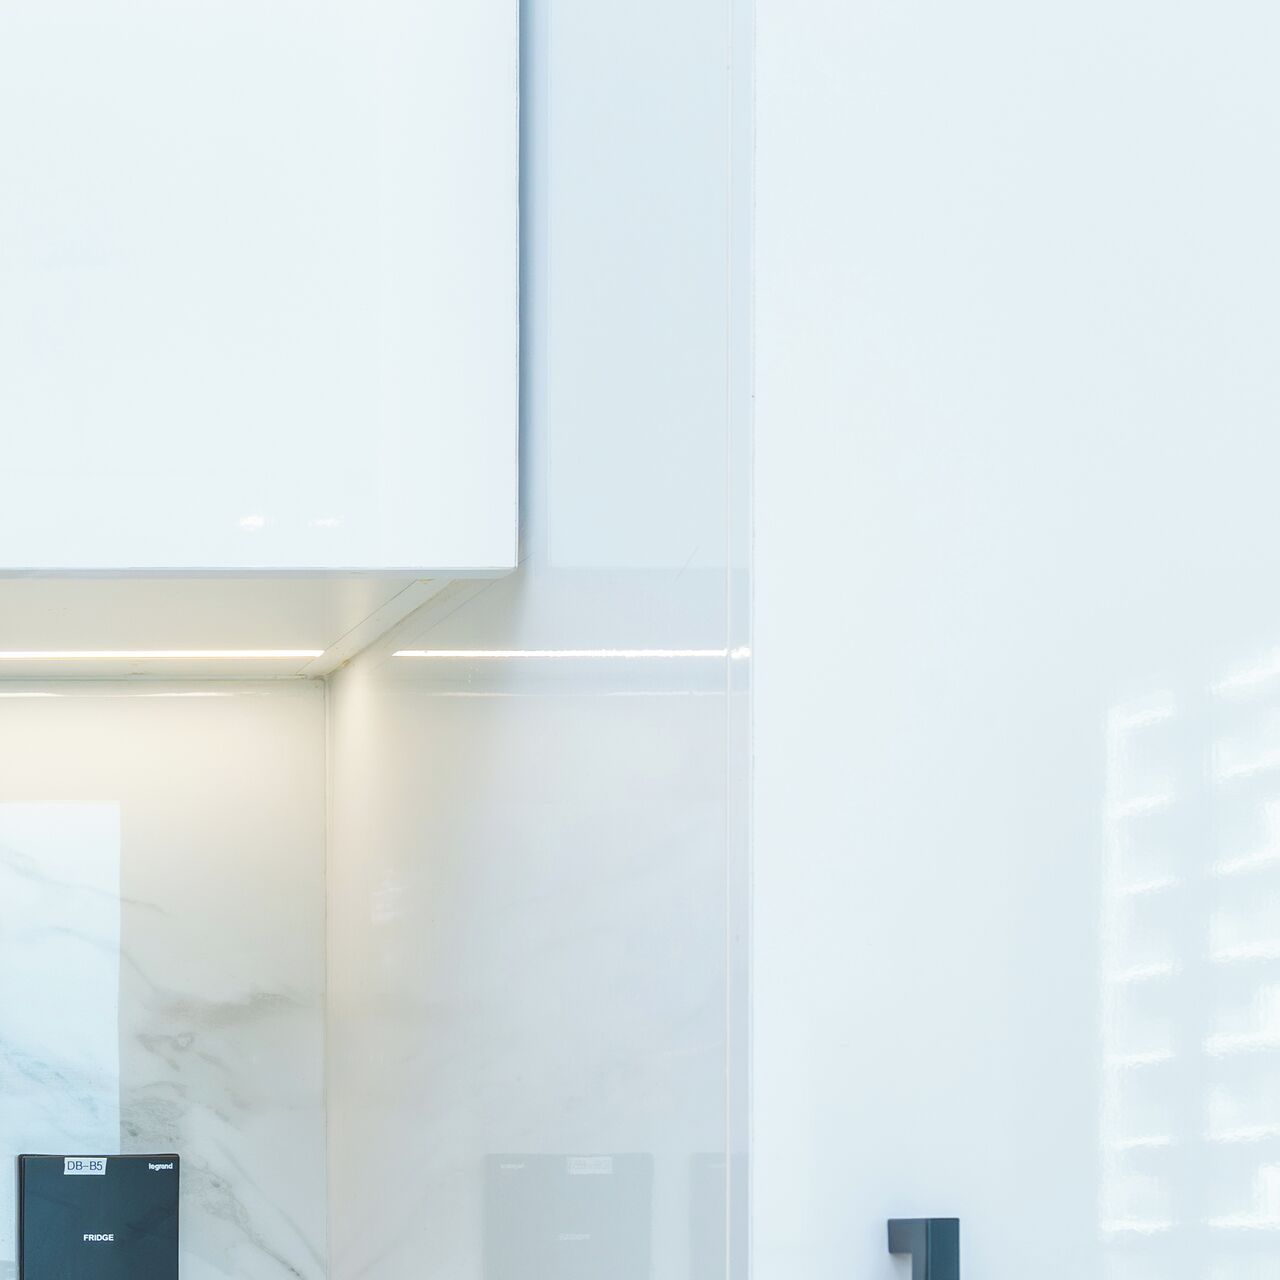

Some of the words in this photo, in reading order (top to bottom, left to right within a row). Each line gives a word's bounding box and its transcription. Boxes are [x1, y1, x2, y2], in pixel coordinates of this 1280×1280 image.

[67, 1160, 103, 1171] DB-B5
[148, 1162, 173, 1171] legrand
[83, 1233, 115, 1242] FRIDGE
